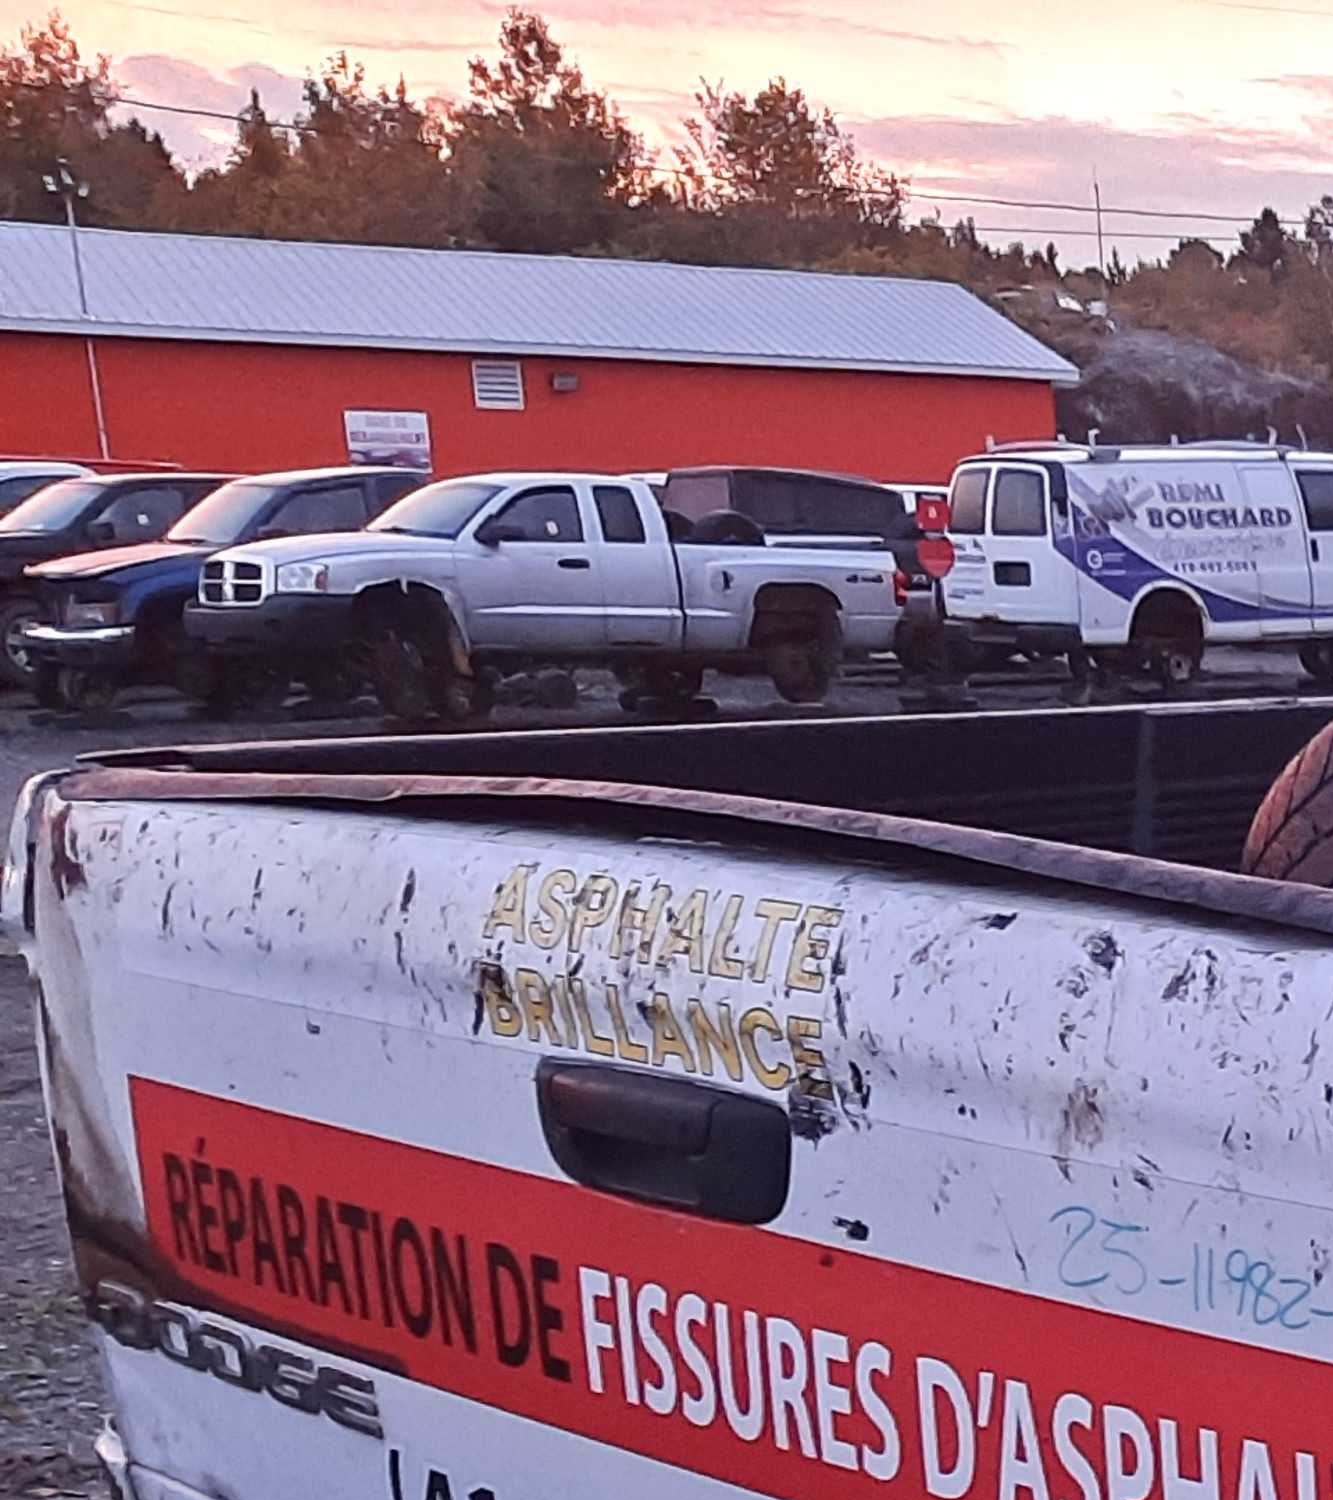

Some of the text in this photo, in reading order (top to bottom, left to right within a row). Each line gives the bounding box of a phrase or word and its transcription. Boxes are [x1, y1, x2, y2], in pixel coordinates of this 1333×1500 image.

[1147, 508, 1293, 530] BOUCHARD
[482, 862, 844, 993] ASPHALTE
[477, 960, 836, 1103] BRILLANCE
[88, 1280, 384, 1440] DODGE
[163, 1138, 477, 1354] RÉPARATION
[484, 1242, 572, 1383] DE
[578, 1266, 900, 1482] FISSURES
